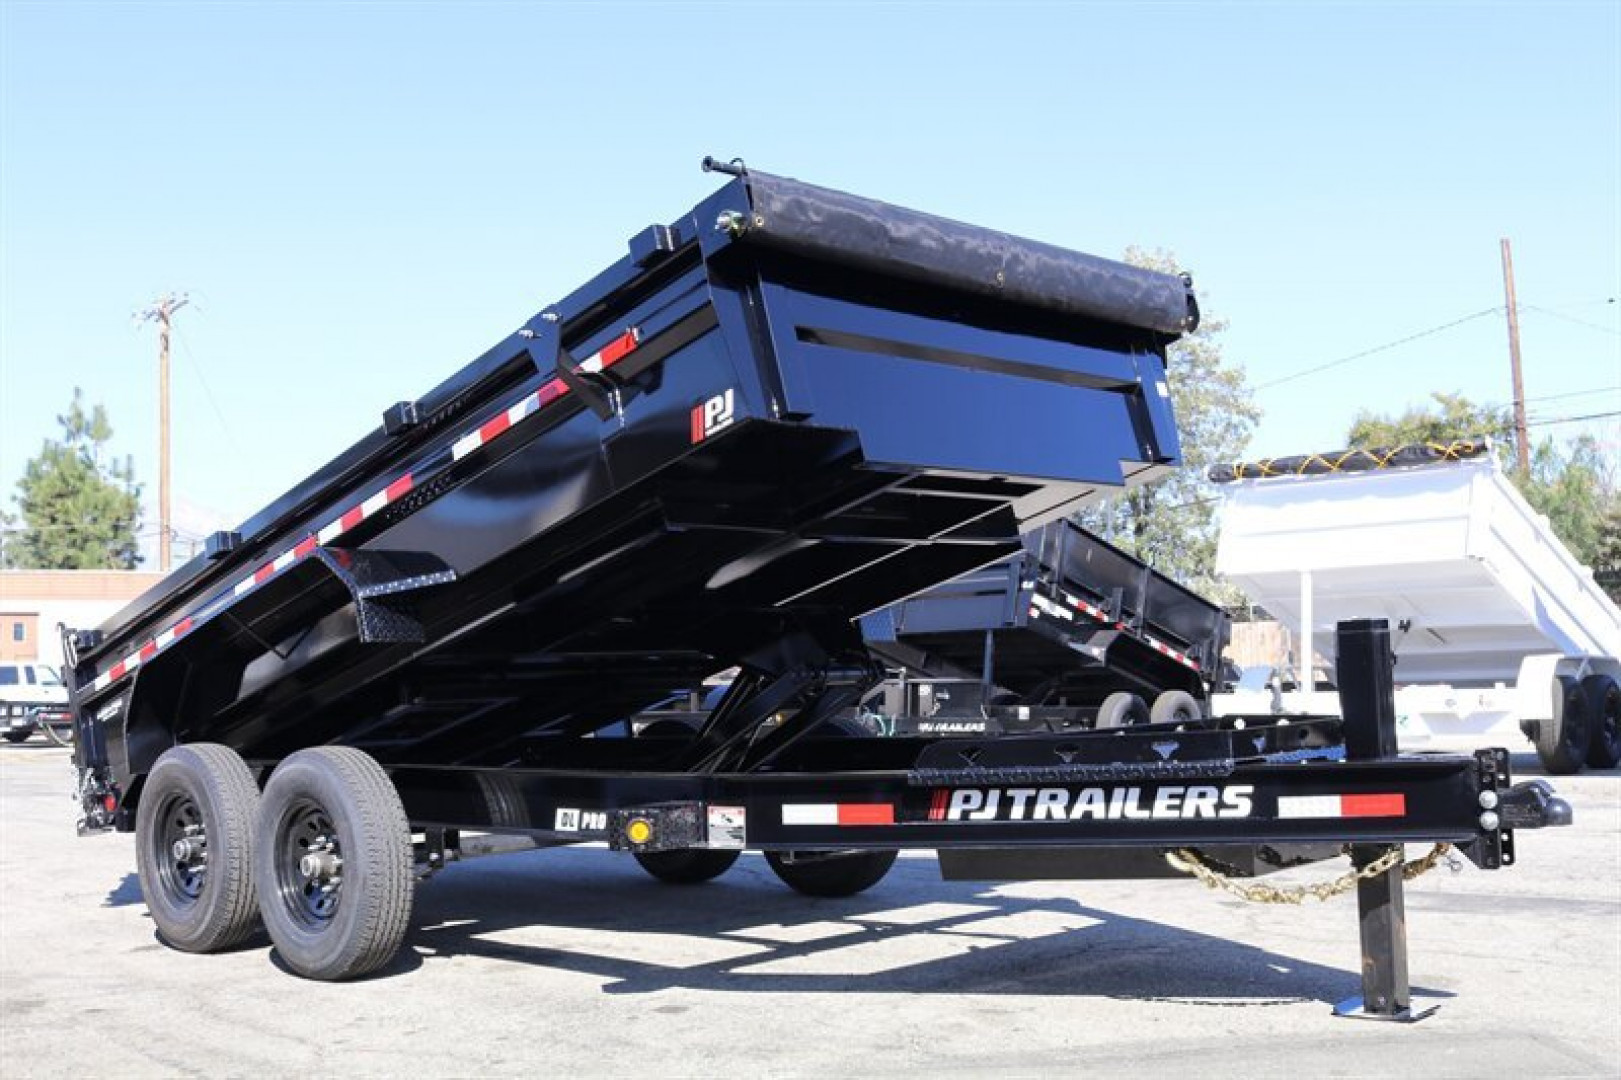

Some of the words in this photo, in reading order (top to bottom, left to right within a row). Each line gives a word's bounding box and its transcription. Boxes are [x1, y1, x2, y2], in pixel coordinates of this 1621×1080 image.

[705, 389, 734, 430] PJ
[948, 789, 999, 819] PJ
[1006, 786, 1254, 819] TRAILERS
